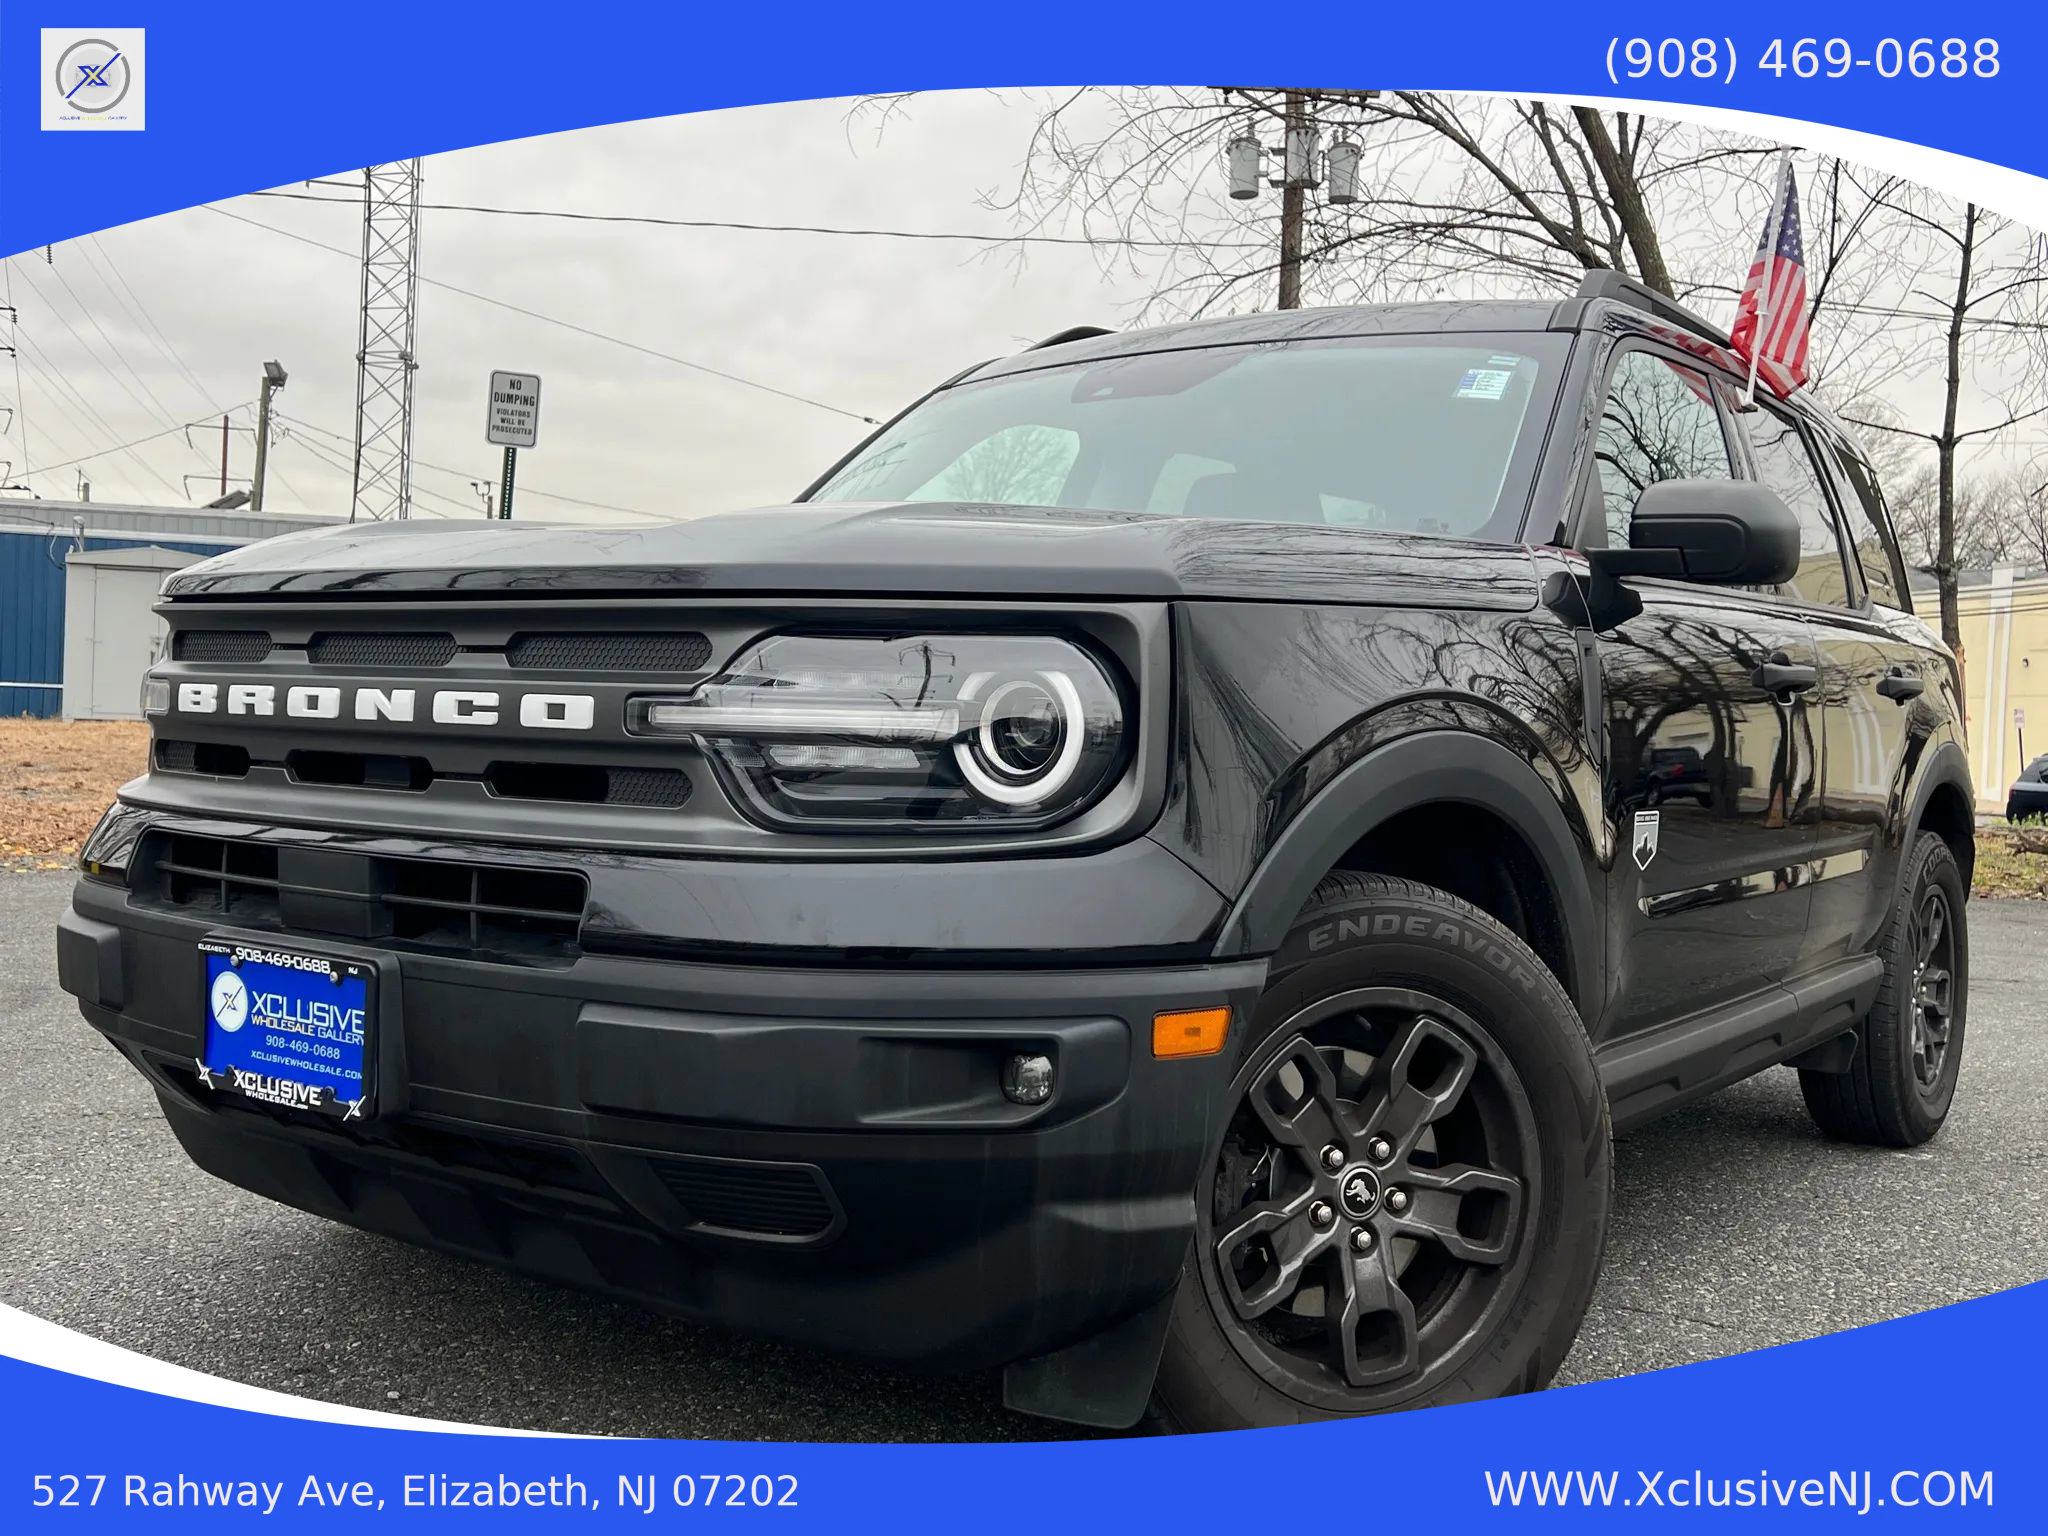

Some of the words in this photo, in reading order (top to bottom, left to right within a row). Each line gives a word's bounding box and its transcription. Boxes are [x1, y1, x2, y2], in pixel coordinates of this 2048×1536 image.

[509, 379, 522, 390] NO
[494, 392, 535, 406] DUMPING
[496, 408, 531, 418] VIOLATORS
[492, 425, 532, 435] PROSECUTED
[177, 683, 595, 730] BRONCO
[198, 943, 231, 954] ELIZABETH
[235, 947, 331, 975] 908-469-0688
[347, 966, 358, 975] NJ
[1307, 913, 1537, 993] ENDEAVOR
[251, 990, 365, 1035] XCLUSIVE
[251, 1015, 315, 1036] WHOLESALE
[265, 1035, 341, 1060] 908-469-0688
[233, 1069, 321, 1106] XCLUSIVE
